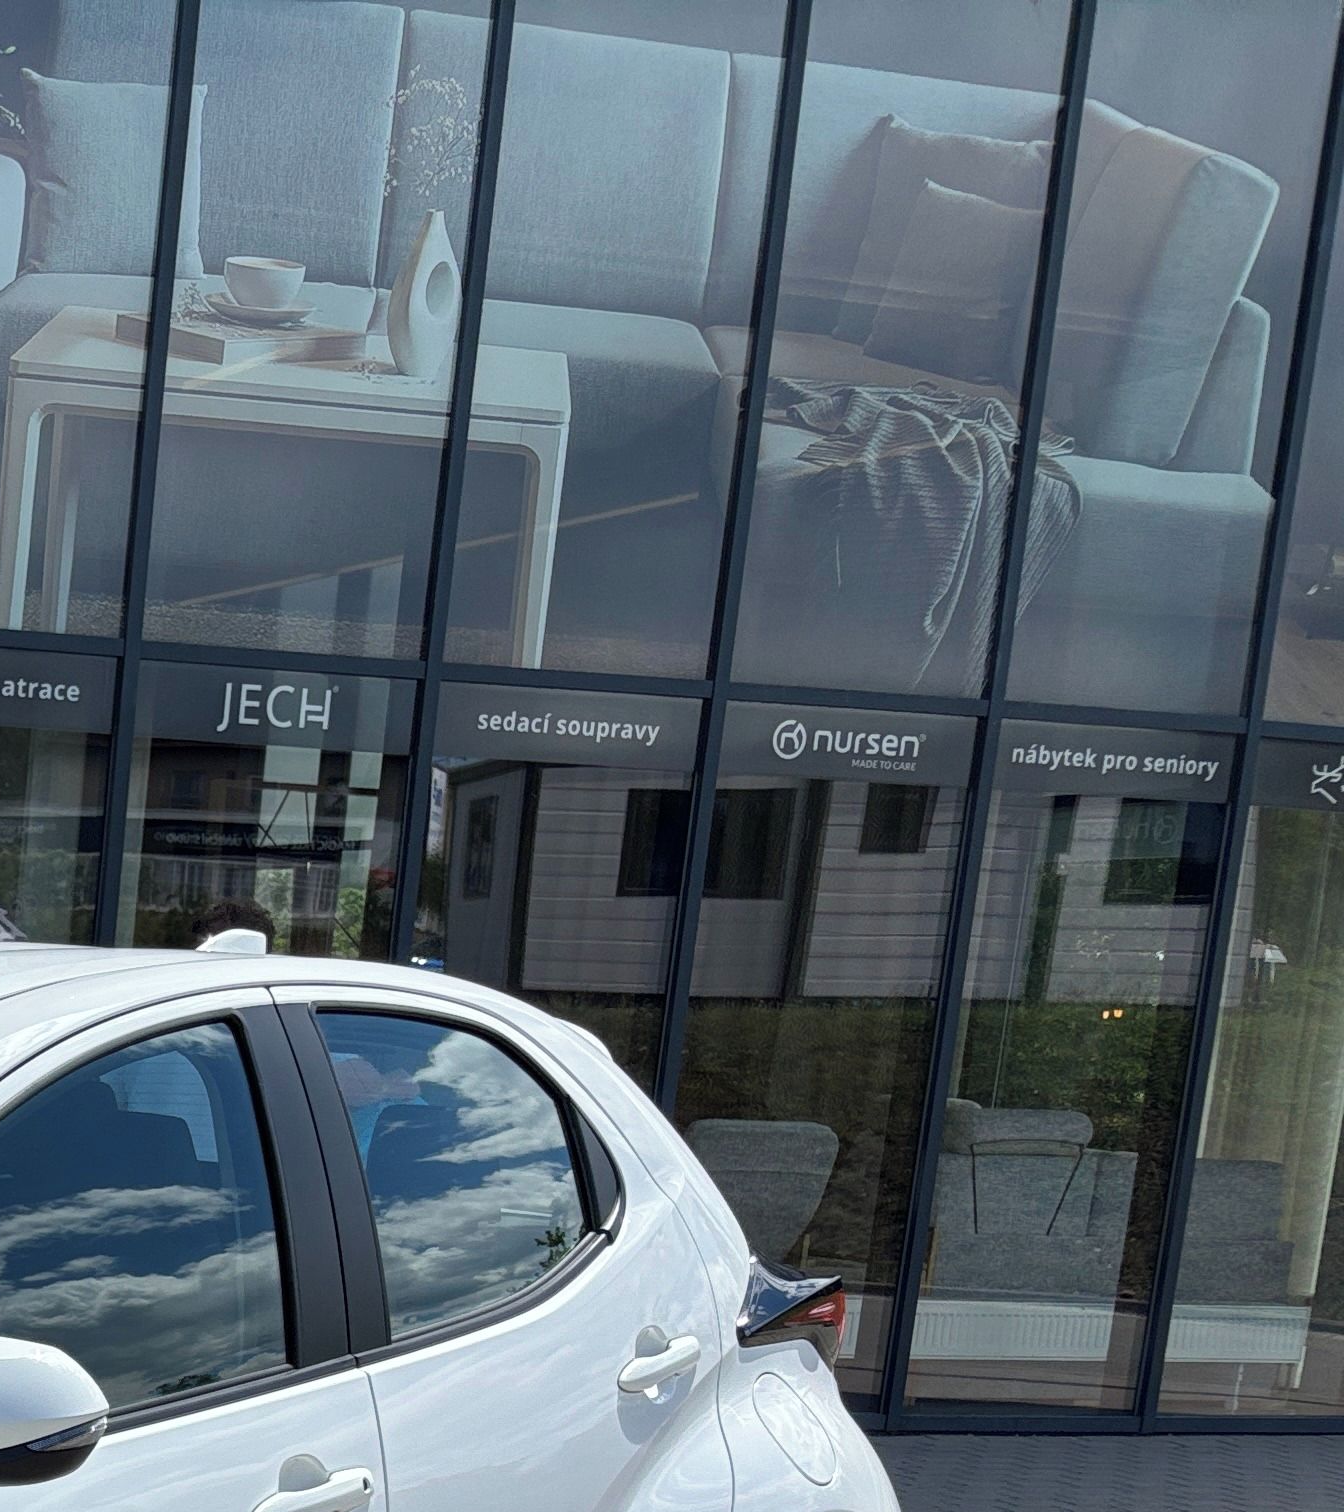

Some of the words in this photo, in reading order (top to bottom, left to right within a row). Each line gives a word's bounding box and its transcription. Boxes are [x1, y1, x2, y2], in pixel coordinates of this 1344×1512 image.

[477, 711, 552, 734] sedací
[555, 718, 661, 747] soupravy
[851, 758, 878, 769] MADE
[880, 760, 892, 770] TO
[892, 760, 916, 771] CARE
[1012, 743, 1097, 770] nábytek
[1101, 754, 1138, 774] pro
[1142, 754, 1220, 782] seniory
